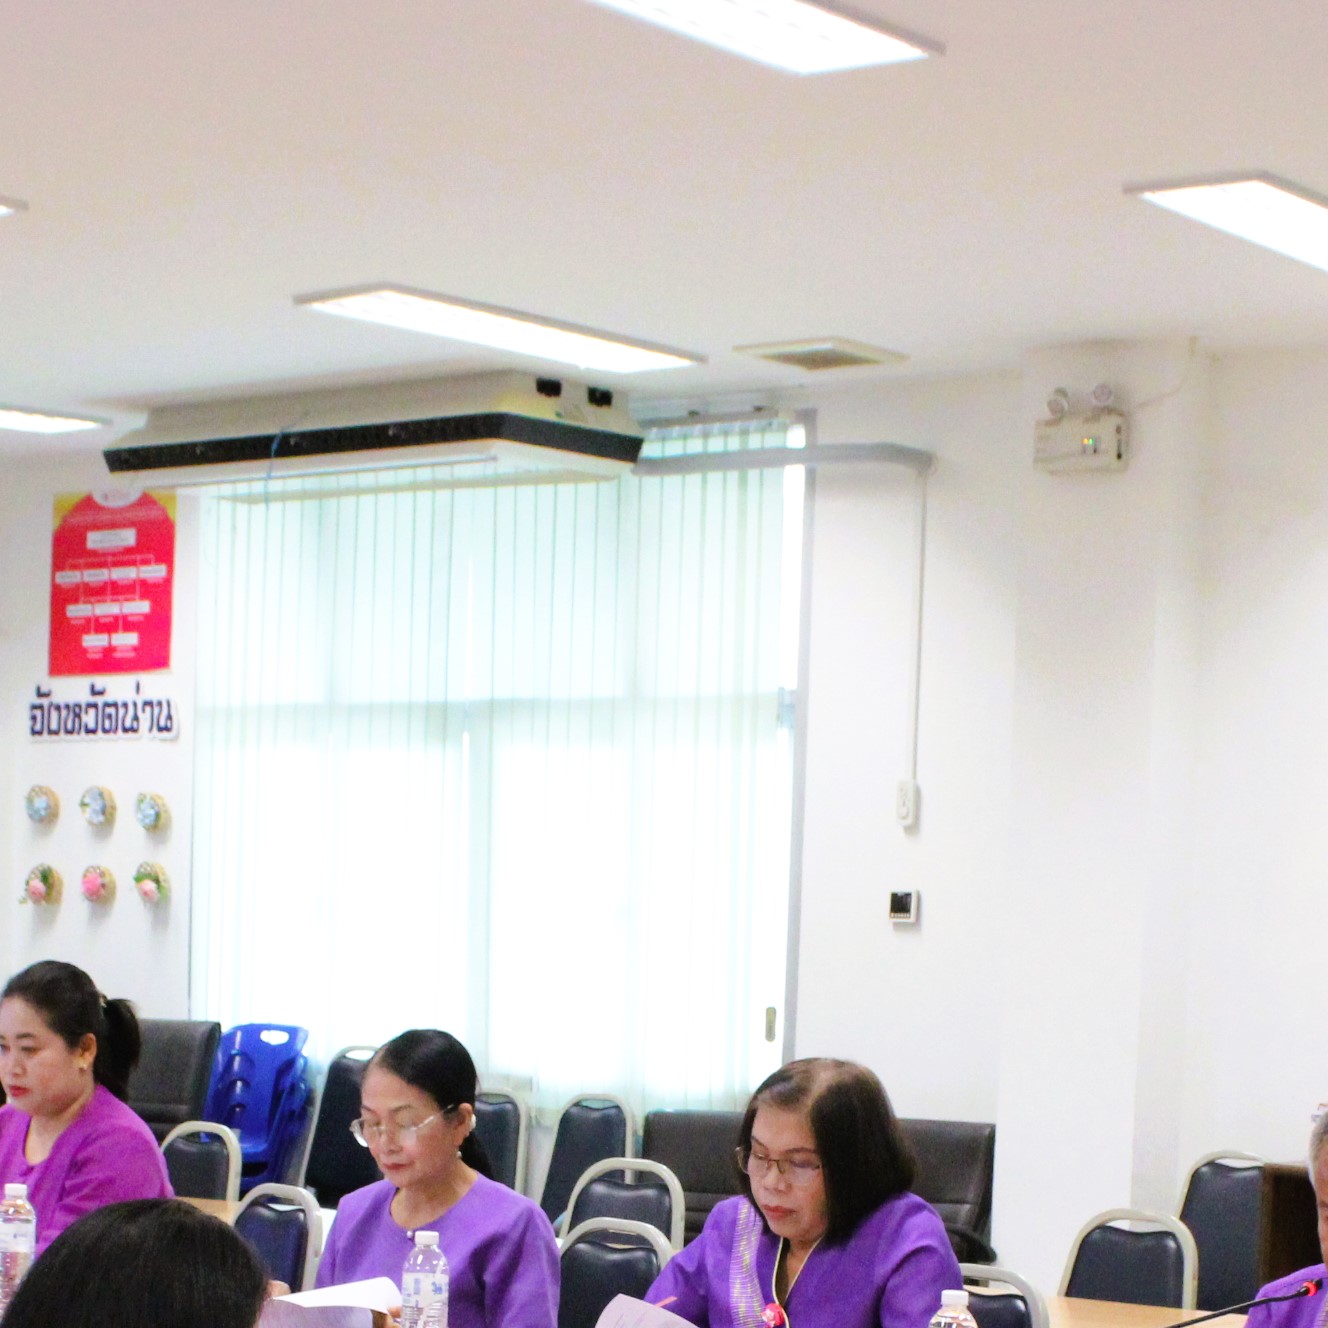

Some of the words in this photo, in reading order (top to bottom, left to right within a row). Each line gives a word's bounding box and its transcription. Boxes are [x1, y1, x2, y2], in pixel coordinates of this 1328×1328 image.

[30, 681, 173, 736] จังหวัดน่าน
